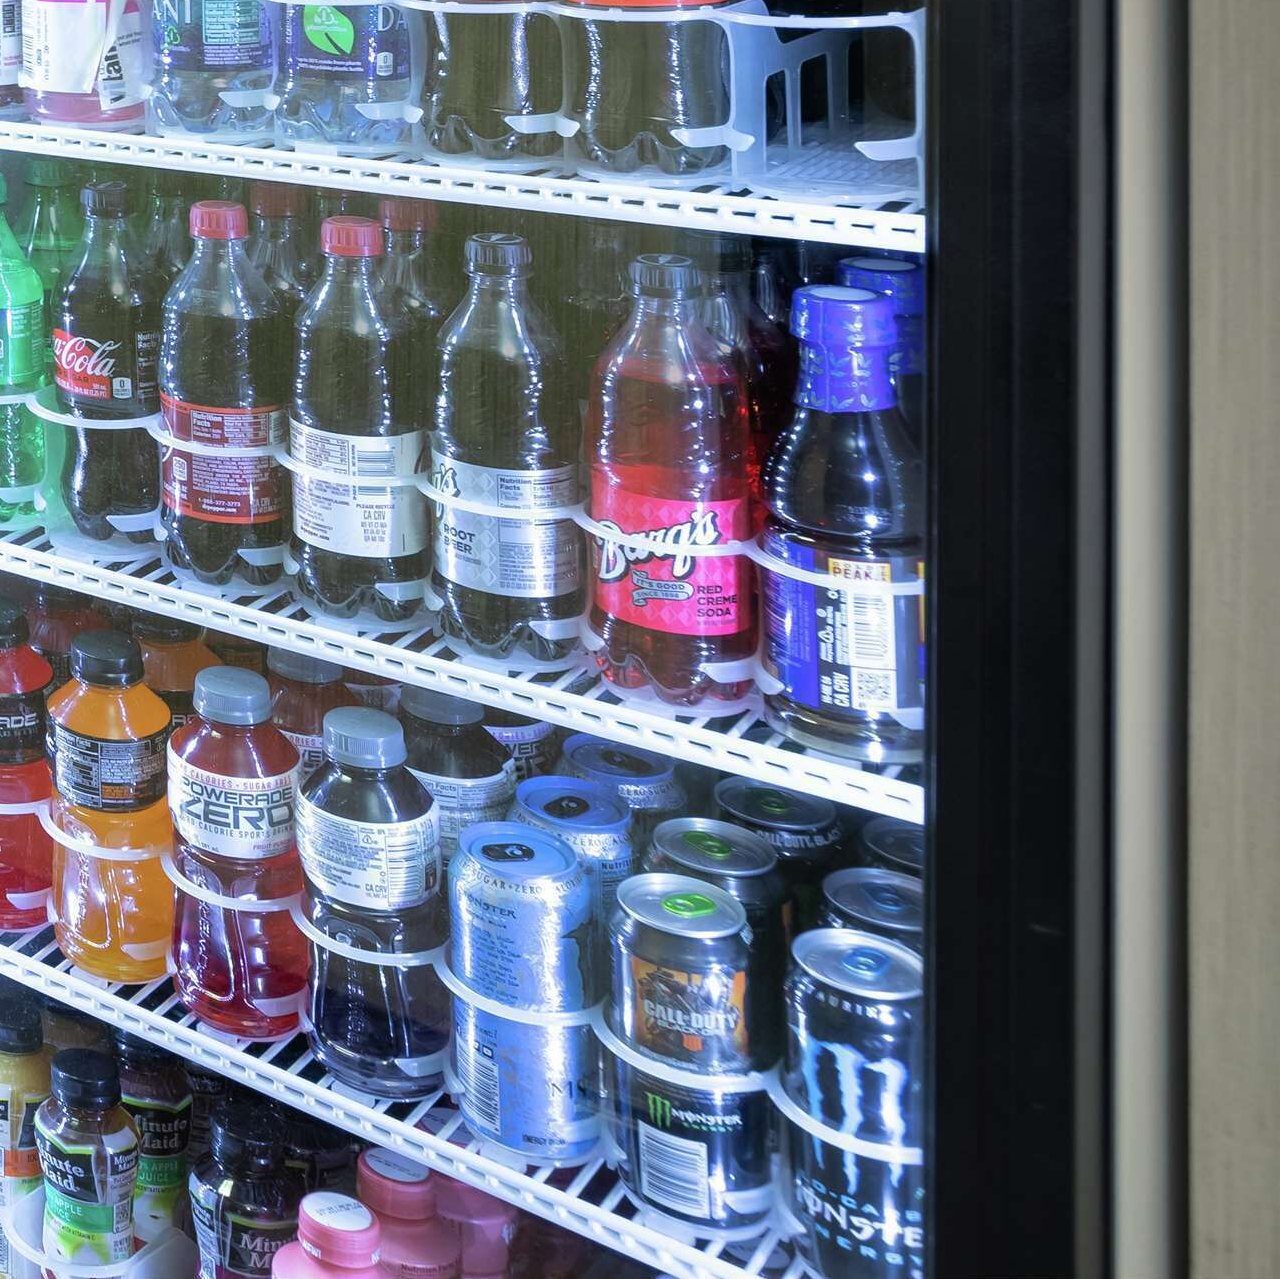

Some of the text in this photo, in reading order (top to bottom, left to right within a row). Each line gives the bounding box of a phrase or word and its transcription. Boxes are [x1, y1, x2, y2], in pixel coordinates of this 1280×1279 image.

[363, 510, 386, 521] CA CRV
[657, 581, 685, 590] GOOD
[697, 585, 722, 595] RED
[697, 594, 737, 606] CREME
[697, 607, 731, 618] SODA
[183, 777, 292, 806] POWERADE
